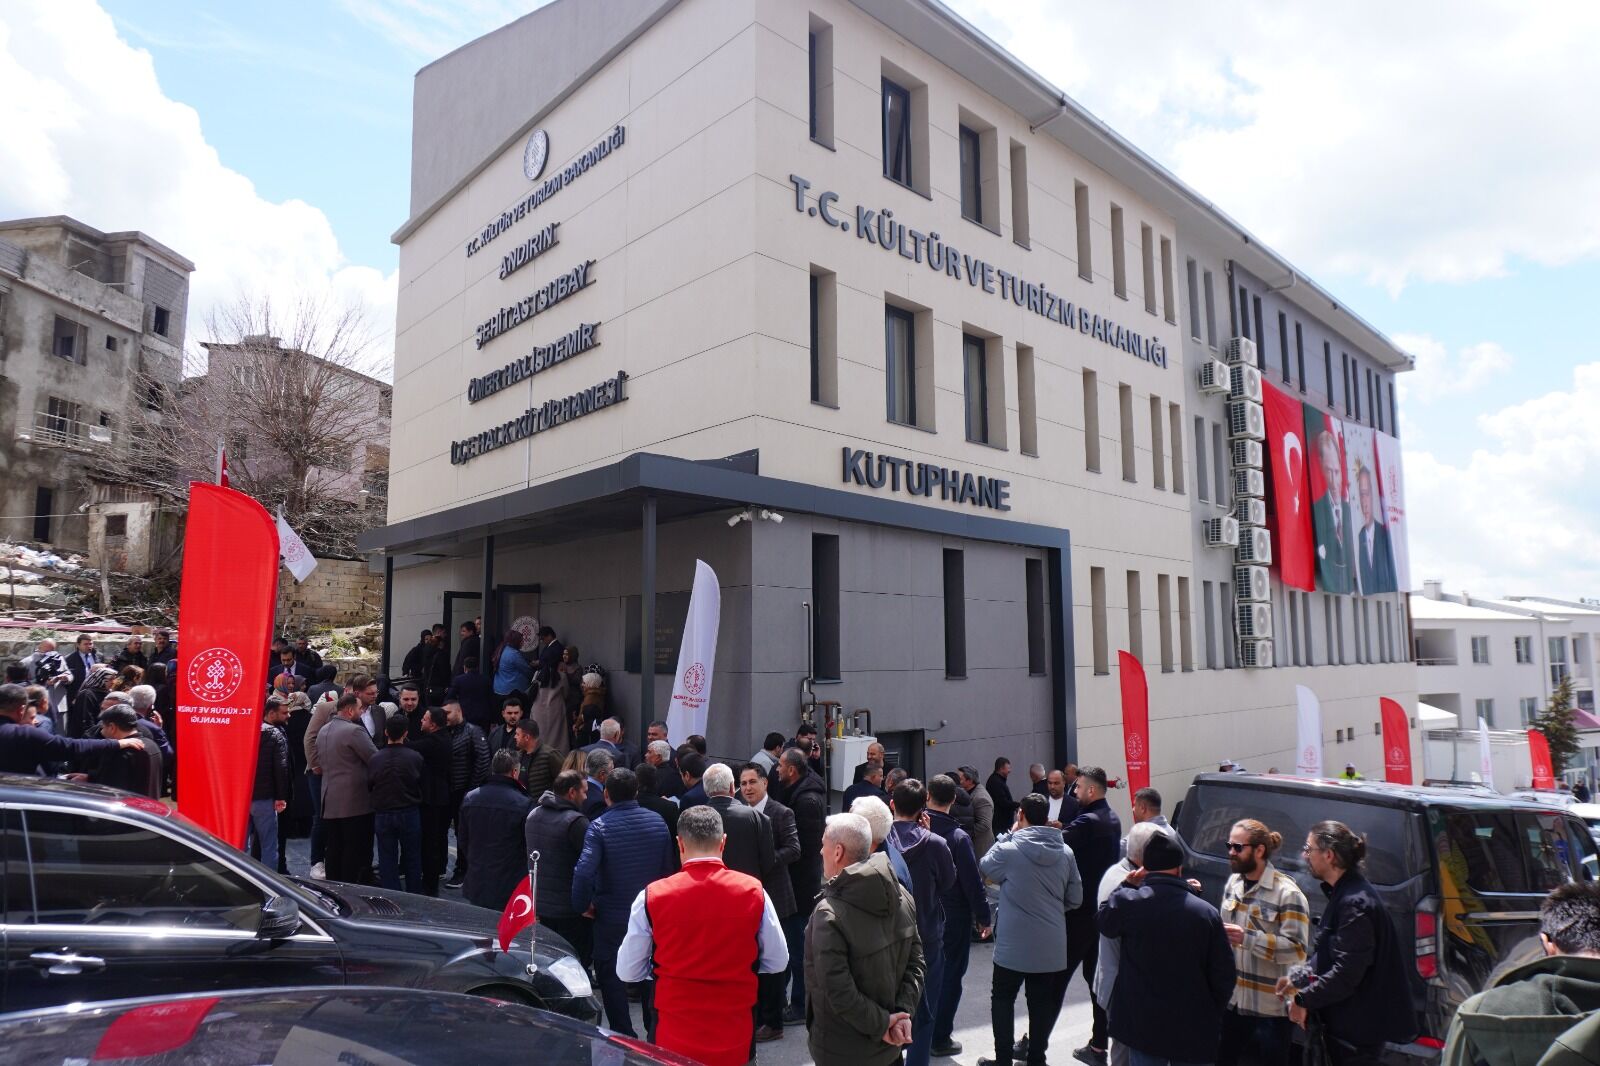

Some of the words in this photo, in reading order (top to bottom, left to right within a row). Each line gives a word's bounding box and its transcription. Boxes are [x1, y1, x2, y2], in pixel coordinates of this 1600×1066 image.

[466, 237, 481, 258] T.C.
[480, 212, 513, 248] KÜLTÜR
[512, 201, 526, 224] VE
[524, 172, 563, 213] TURİZM
[562, 124, 626, 187] BAKANLIĞI
[499, 222, 559, 280] ANDIRIN
[790, 173, 850, 231] T.C.
[856, 205, 962, 280] KÜLTÜR
[964, 254, 996, 294] VE
[998, 269, 1076, 330] TURİZM
[1078, 306, 1169, 369] BAKANLIĞI
[475, 307, 513, 350] ŞEHİT
[511, 259, 595, 326] ASTSUBAY
[468, 368, 502, 405] ÖMER
[502, 322, 600, 388] HALİSDEMİR
[475, 420, 515, 456] HALK
[514, 370, 628, 440] KÜTÜPHANESİ
[842, 446, 1011, 512] KÜTÜPHANE
